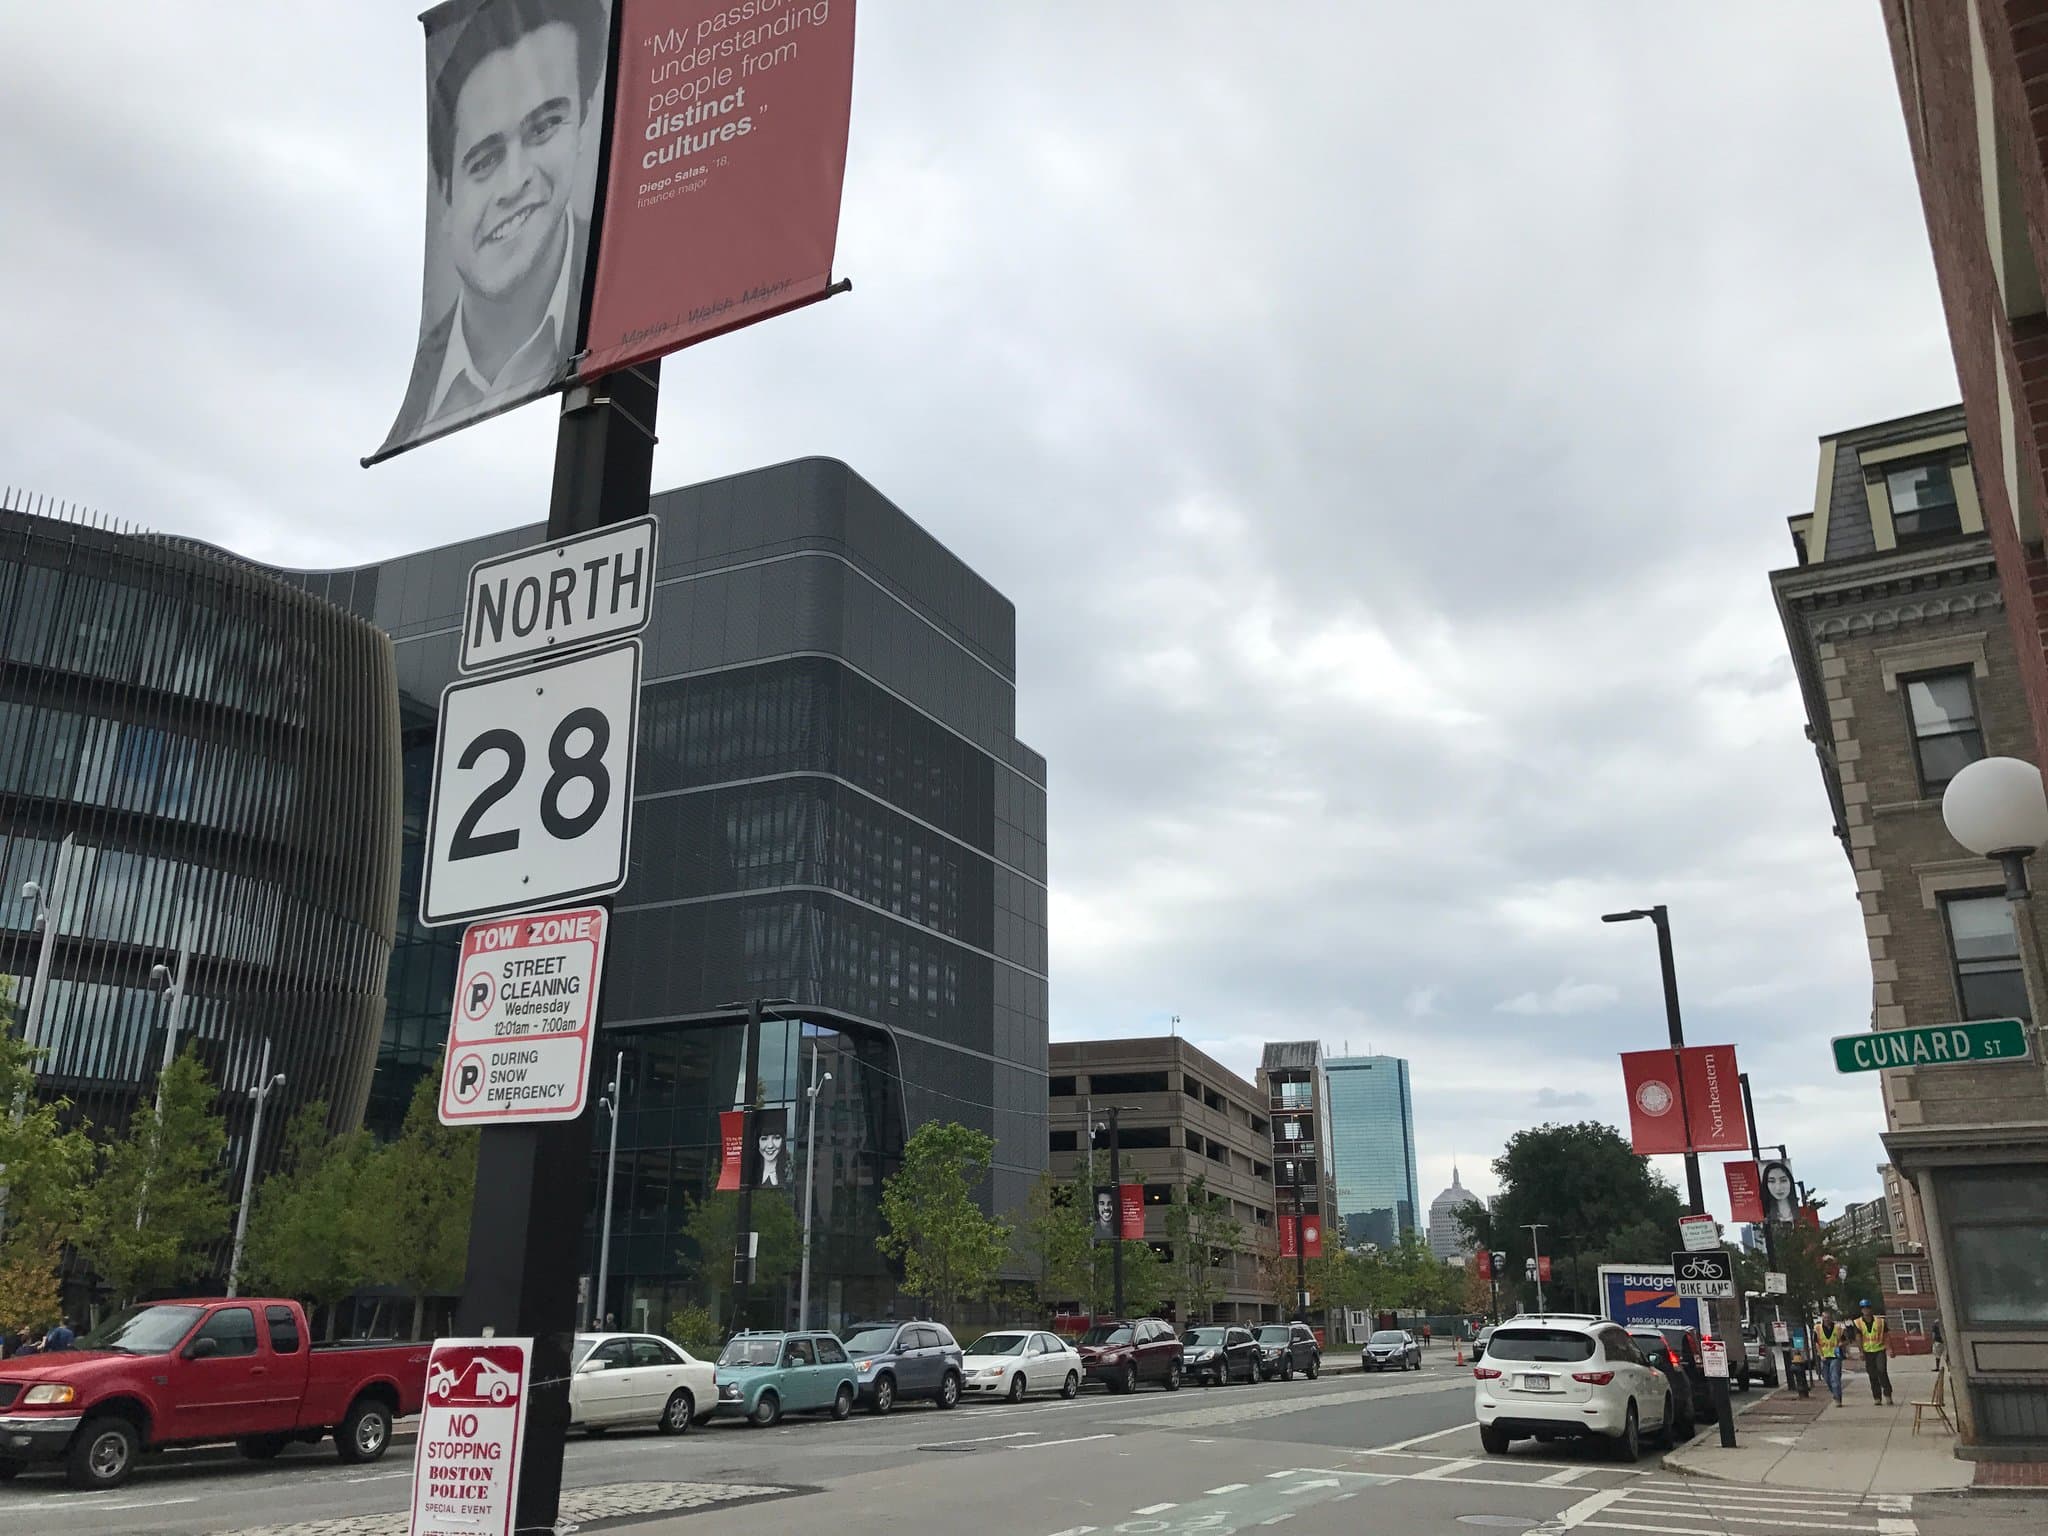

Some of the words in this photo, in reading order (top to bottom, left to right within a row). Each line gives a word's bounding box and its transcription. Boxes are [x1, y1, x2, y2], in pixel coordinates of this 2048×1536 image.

[644, 28, 689, 57] “My
[651, 0, 829, 84] understanding
[648, 66, 733, 119] people
[741, 42, 798, 78] from
[645, 86, 745, 140] distinct
[639, 177, 672, 195] Diego
[674, 165, 709, 183] Salas,
[637, 189, 676, 208] finance
[678, 178, 708, 194] major
[473, 548, 644, 649] NORTH
[448, 707, 611, 862] 28
[473, 925, 519, 951] TOW
[528, 916, 592, 944] ZONE
[503, 956, 567, 979] STREET
[500, 976, 580, 1001] CLEANING
[505, 999, 571, 1017] Wednesday
[494, 1021, 530, 1036] 12:01am
[542, 1017, 577, 1033] 7:00am
[491, 1050, 539, 1066] DURING
[1853, 1030, 1971, 1068] CUNARD
[1984, 1039, 2001, 1056] ST
[489, 1069, 528, 1084] SNOW
[487, 1083, 565, 1102] EMERGENCY
[1704, 1053, 1725, 1138] Northeastern
[1623, 1274, 1674, 1291] Budge
[1680, 1282, 1702, 1295] BIKE
[448, 1414, 479, 1438] NO
[427, 1441, 501, 1460] STOPPING
[429, 1466, 493, 1481] BOSTON
[430, 1483, 489, 1500] POLICE
[424, 1503, 456, 1514] SPECIAL
[461, 1505, 492, 1515] EVENT
